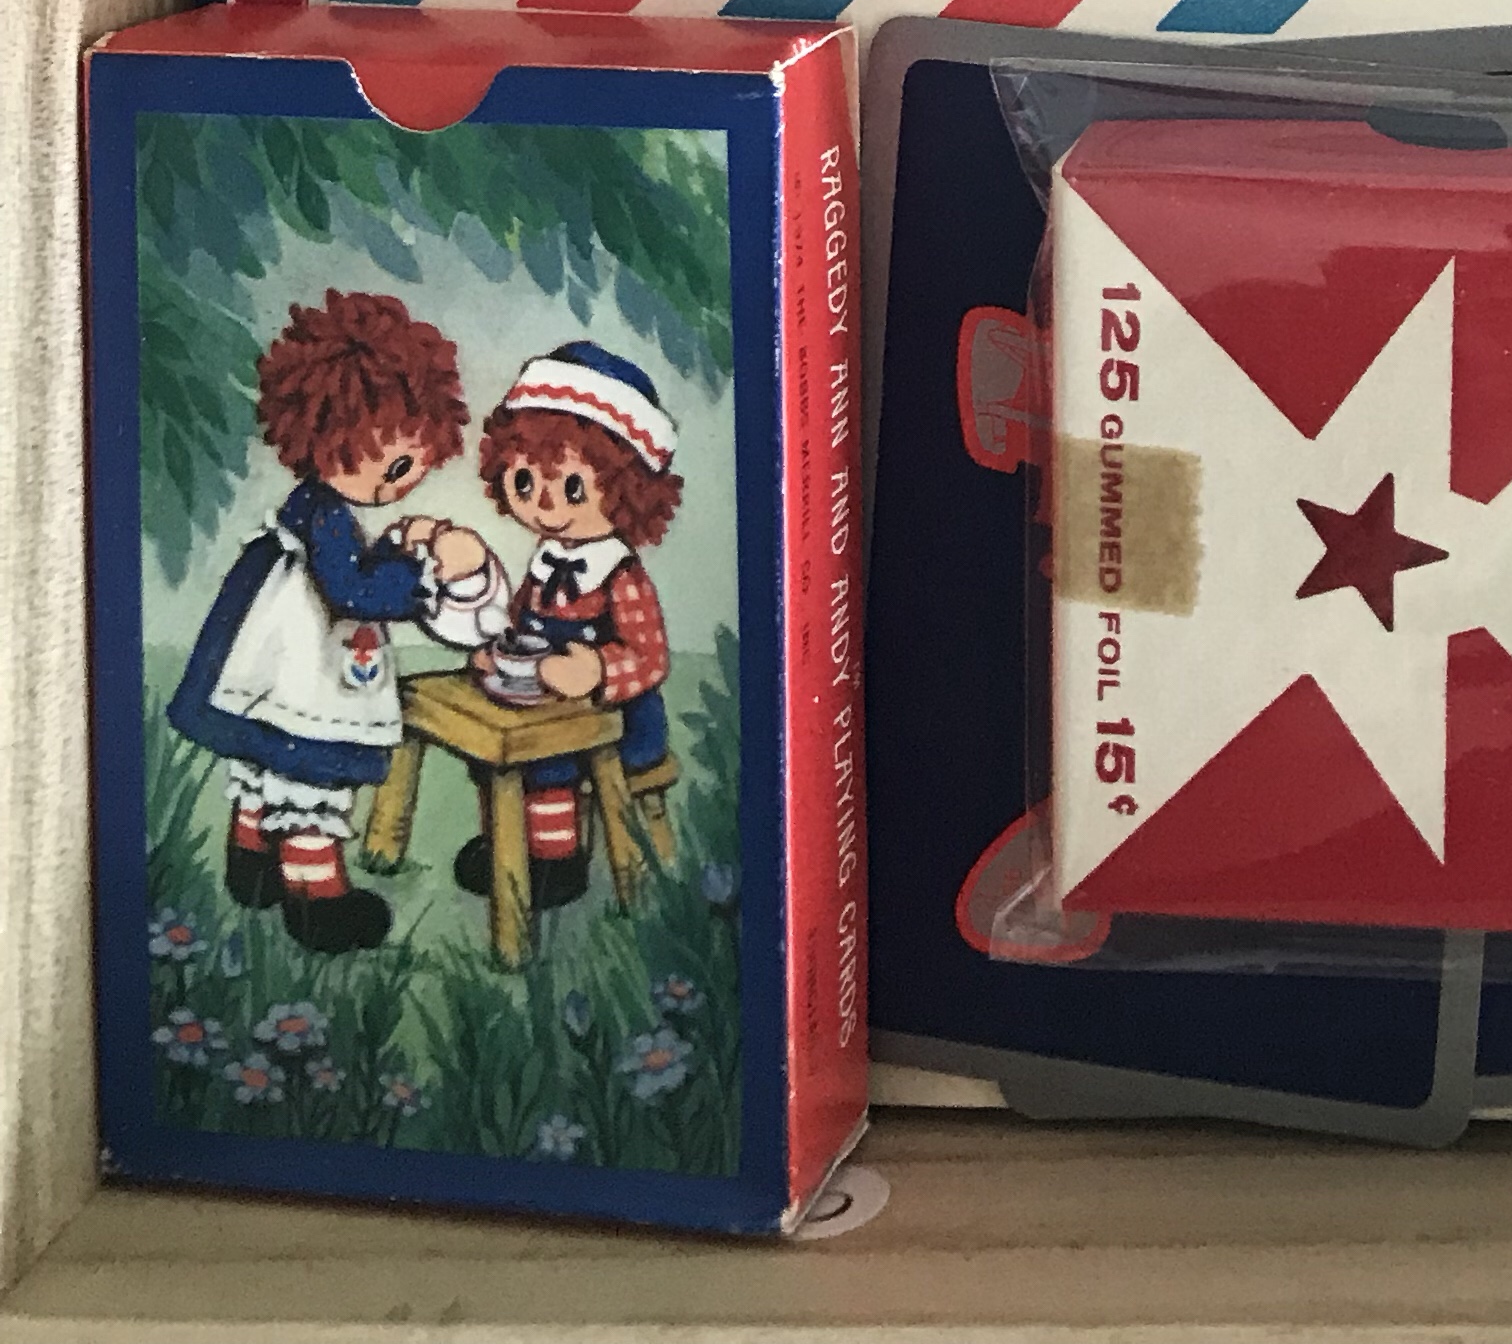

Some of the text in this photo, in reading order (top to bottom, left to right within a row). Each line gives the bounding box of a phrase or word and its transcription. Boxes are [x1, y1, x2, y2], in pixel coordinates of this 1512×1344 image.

[820, 143, 860, 1049] RAGGEDY ANN AND ANDY PLAYING CARDS
[1094, 282, 1142, 818] 125 GUMMED FOIL 15¢
